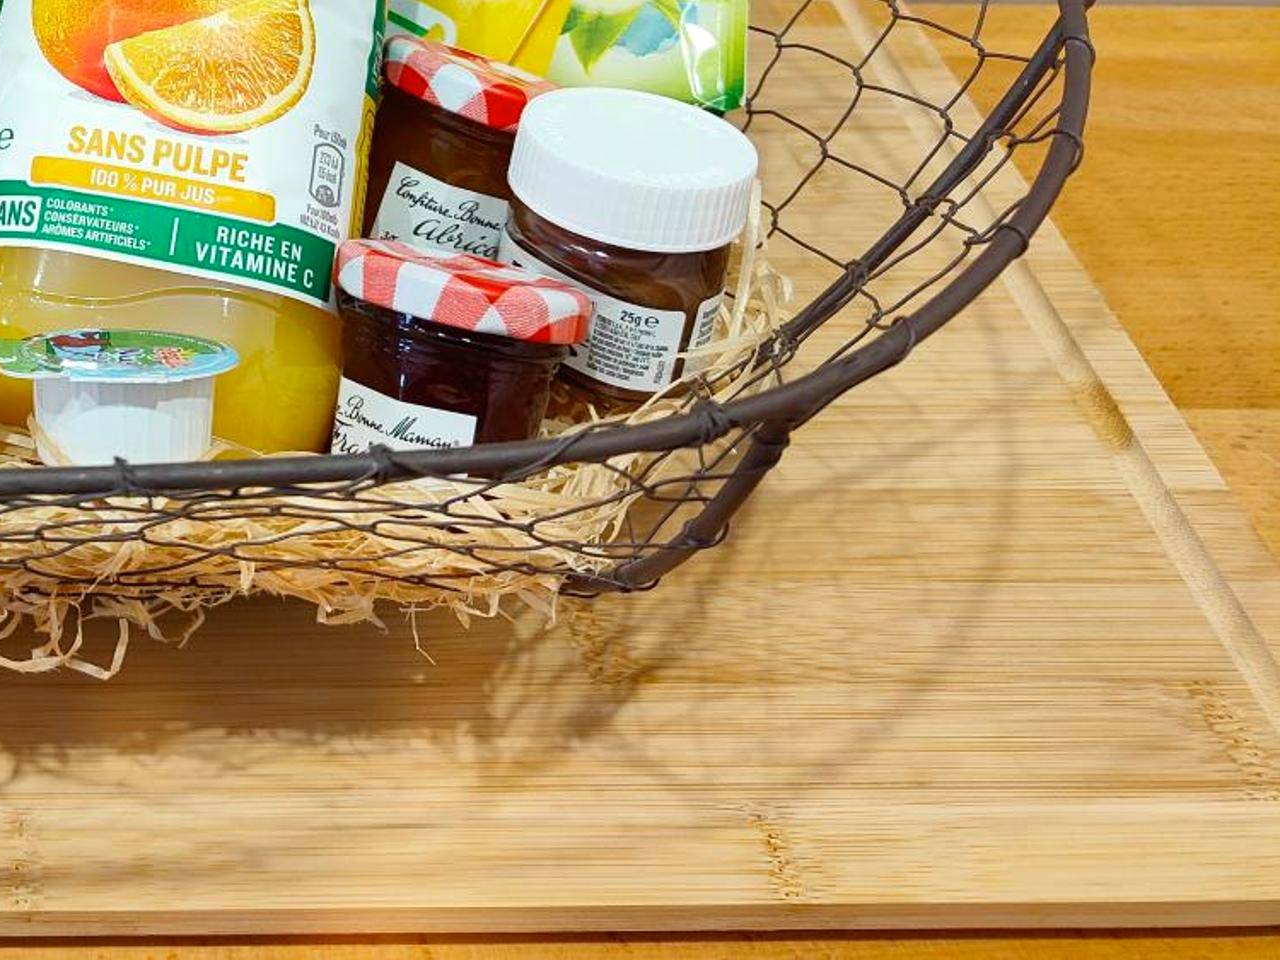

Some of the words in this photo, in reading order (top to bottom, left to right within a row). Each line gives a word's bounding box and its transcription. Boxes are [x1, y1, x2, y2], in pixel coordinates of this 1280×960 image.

[67, 125, 147, 164] SANS
[152, 139, 250, 183] PULPE
[90, 167, 119, 188] 100
[141, 177, 176, 197] PUR
[180, 183, 216, 204] JUS
[395, 176, 452, 220] Confiture
[453, 200, 502, 232] Bonne
[216, 225, 275, 254] RICHE
[281, 240, 302, 262] EN
[413, 218, 497, 258] Abrico
[195, 241, 298, 283] VITAMINE
[303, 268, 314, 288] C
[344, 395, 384, 433] Bonne
[385, 416, 453, 450] Maman
